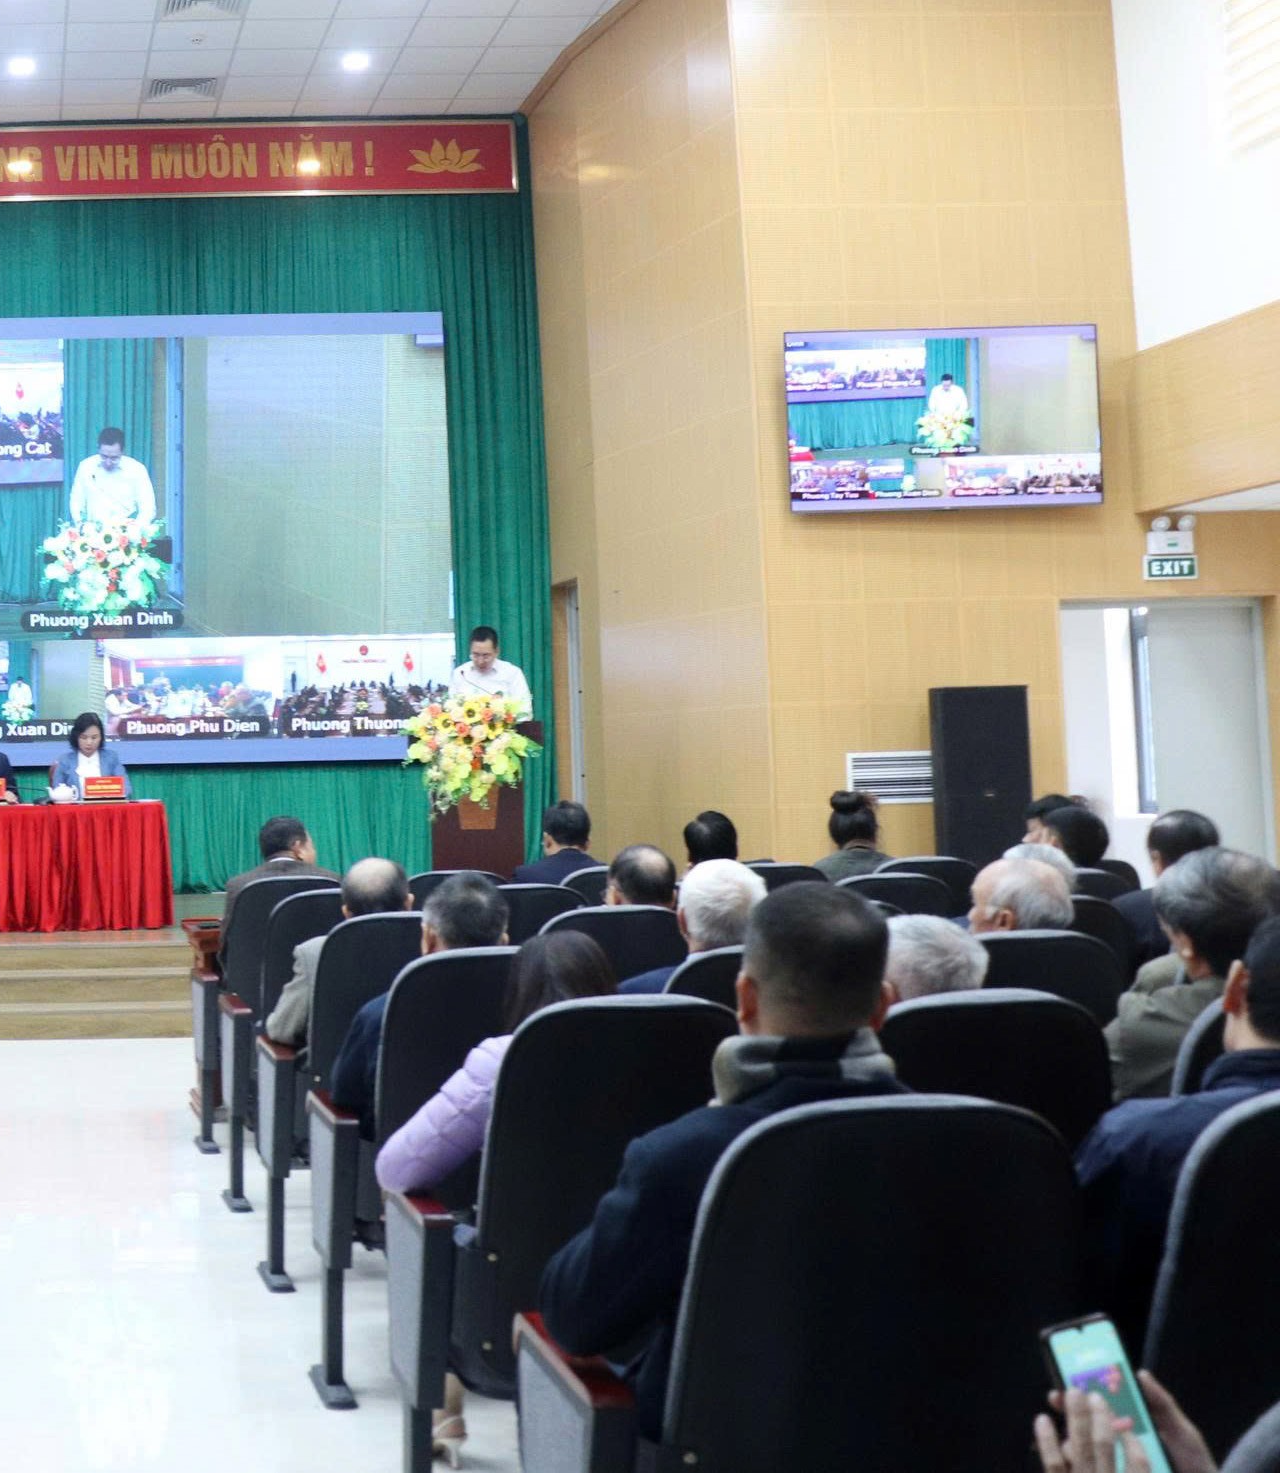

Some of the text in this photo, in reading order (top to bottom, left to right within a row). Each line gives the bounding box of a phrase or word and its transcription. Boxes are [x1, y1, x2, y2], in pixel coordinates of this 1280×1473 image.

[54, 145, 138, 181] VINH
[151, 134, 258, 179] MUÔN
[269, 133, 353, 177] NĂM
[25, 442, 52, 455] Cat
[1151, 560, 1191, 576] EXIT
[30, 611, 173, 629] Phuong Xuan Dinh
[6, 722, 47, 736] Xuan
[126, 719, 260, 736] Phuong Phu Dien
[292, 718, 350, 733] Phuong
